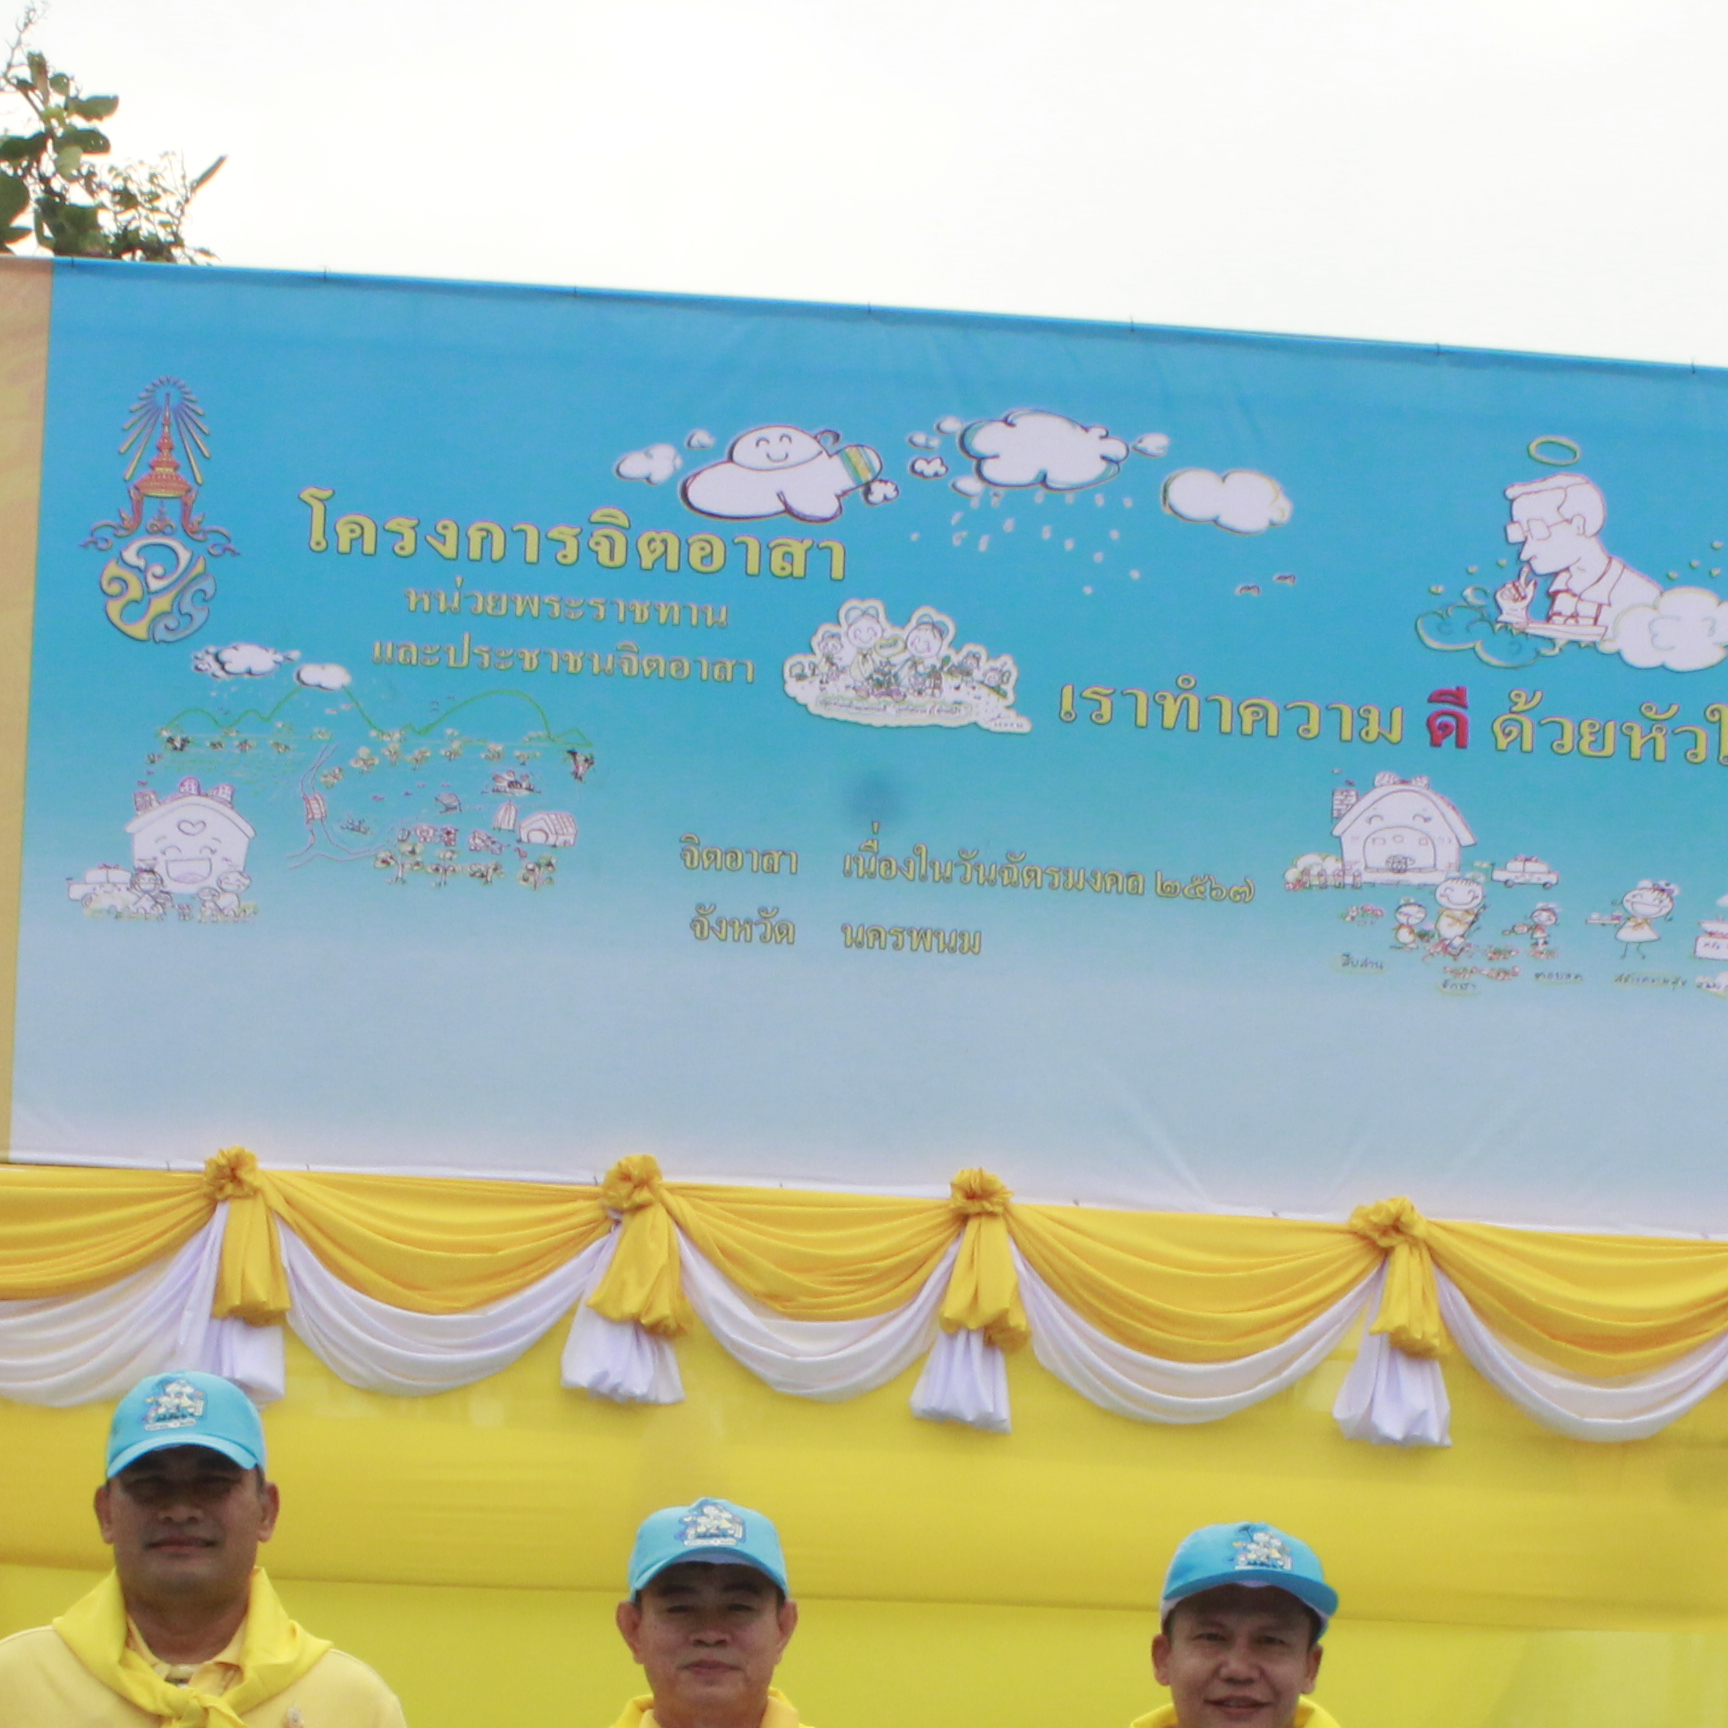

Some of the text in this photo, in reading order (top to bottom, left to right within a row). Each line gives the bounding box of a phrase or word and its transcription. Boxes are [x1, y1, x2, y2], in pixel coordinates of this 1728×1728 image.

[299, 486, 847, 581] โครงการจิตอาสา
[404, 574, 728, 628] หน่วยพระราชทาน
[372, 631, 755, 683] และประชาชนจิตอาสา
[1059, 673, 1404, 744] เราทำความ
[1426, 685, 1470, 750] ดี
[679, 822, 1256, 904] จิตอาสา เนื่องในวันฉัตรมงคล ๒๕๖๗
[689, 903, 982, 955] จังหวัด นครพนม
